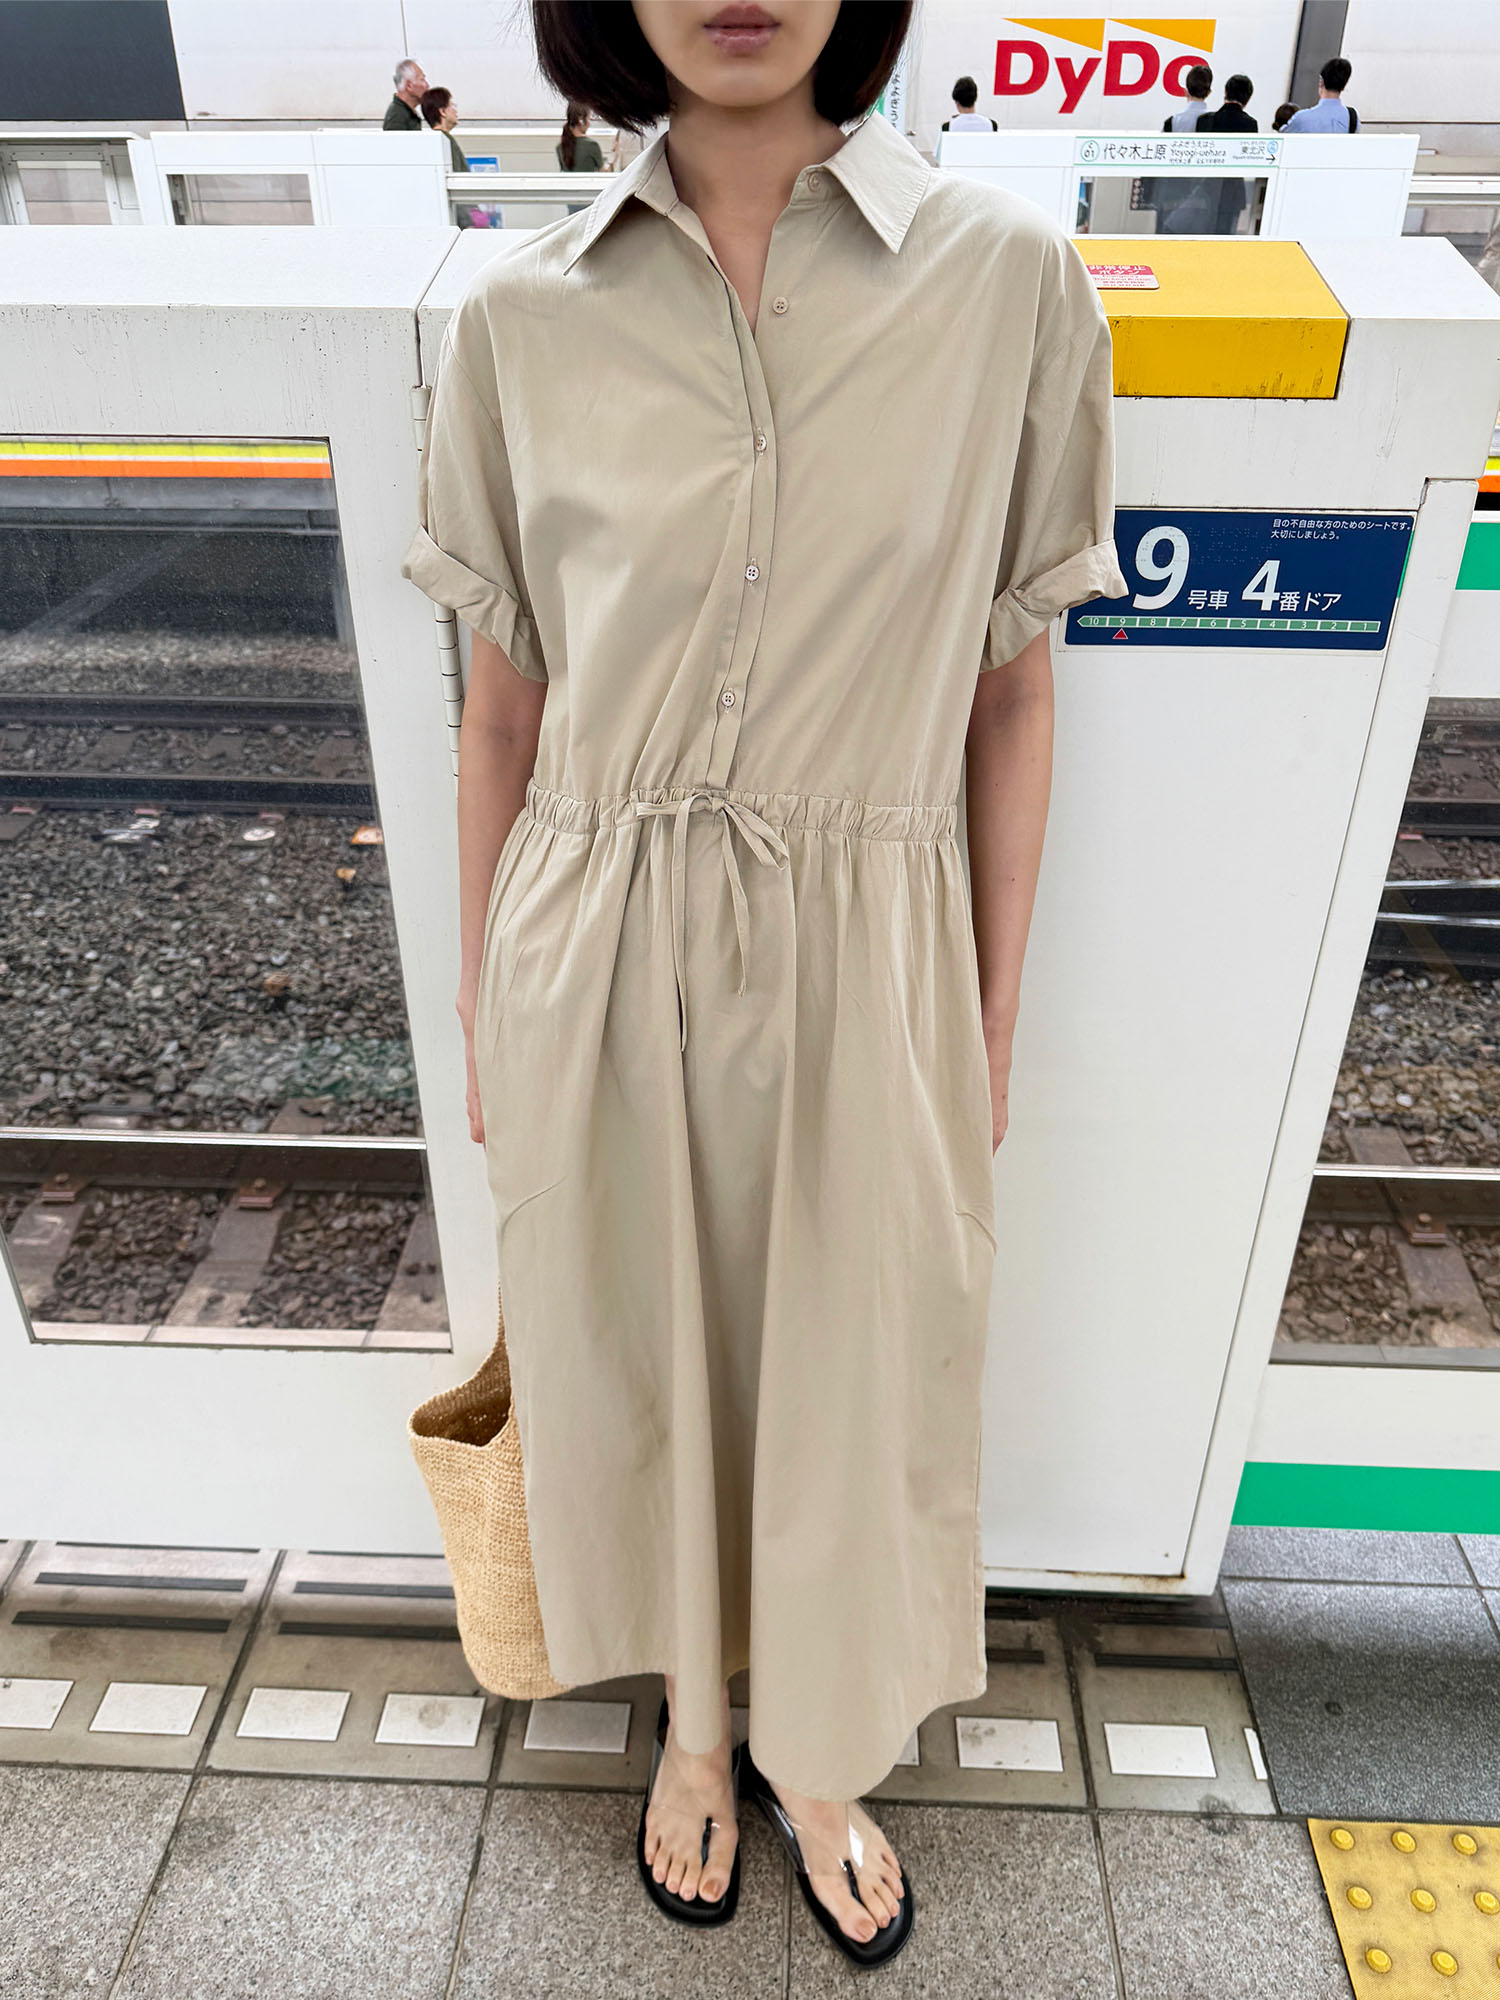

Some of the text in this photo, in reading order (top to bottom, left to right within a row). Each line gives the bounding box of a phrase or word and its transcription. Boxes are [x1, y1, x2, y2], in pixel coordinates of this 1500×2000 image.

[1103, 143, 1167, 160] 代々木上原
[1271, 530, 1340, 540] 大切にしましょう。
[1088, 616, 1100, 626] 10
[1119, 617, 1127, 626] 9
[1150, 618, 1157, 626] 8
[1180, 618, 1187, 627] 7
[1210, 619, 1217, 627] 6
[1240, 620, 1247, 628] 5
[1269, 620, 1276, 628] 4
[1302, 620, 1308, 629] 3
[1331, 621, 1337, 630] 2
